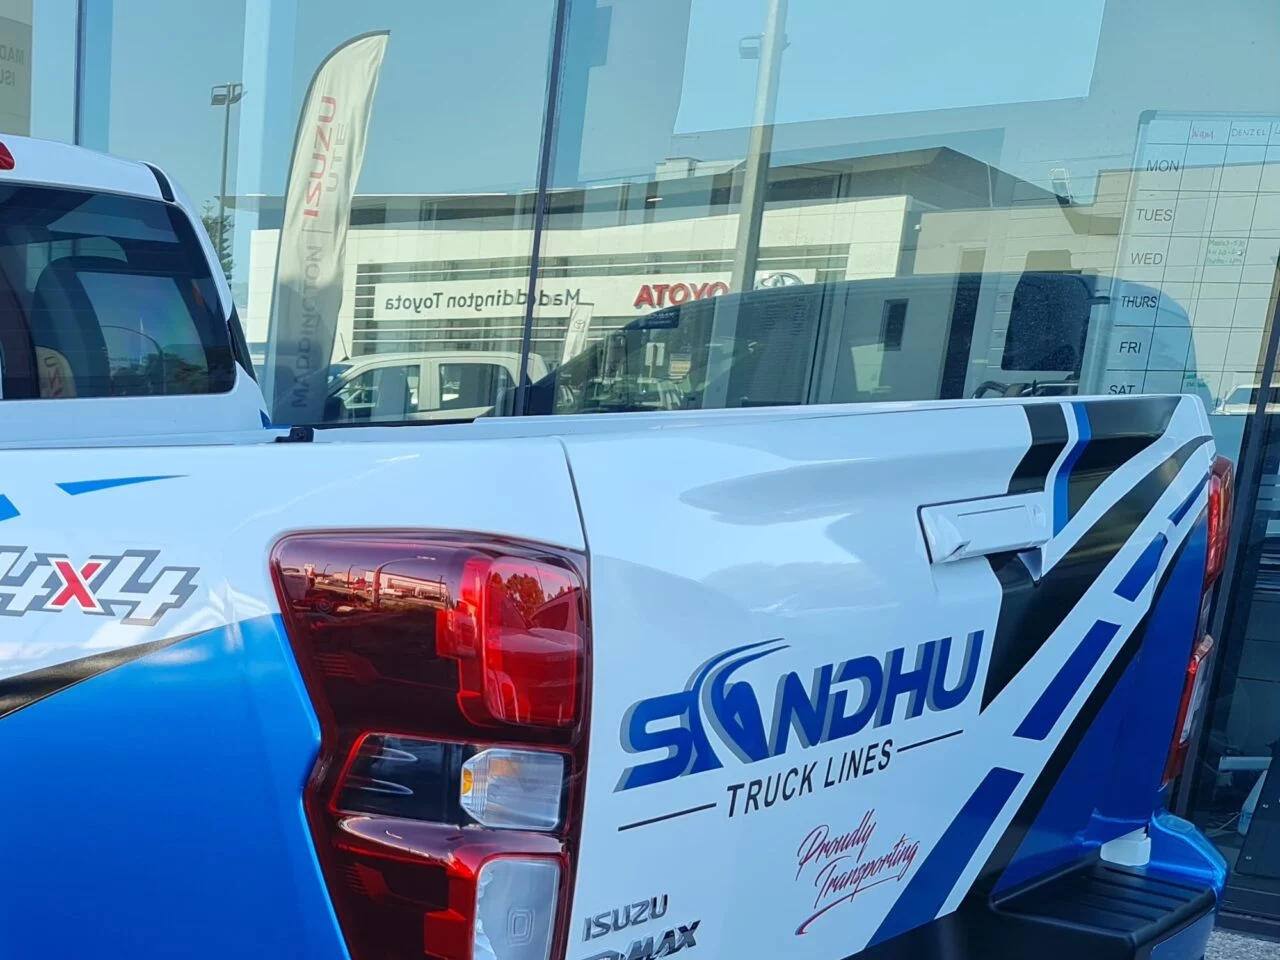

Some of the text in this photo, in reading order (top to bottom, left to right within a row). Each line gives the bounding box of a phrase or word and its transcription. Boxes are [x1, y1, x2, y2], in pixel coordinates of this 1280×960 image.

[303, 96, 337, 218] ISUZU
[326, 122, 349, 193] UTE
[1146, 159, 1180, 173] MON
[1136, 208, 1173, 222] TUES
[1130, 252, 1163, 265] WED
[292, 245, 324, 409] MADDINGTON
[1121, 295, 1158, 309] THURS
[1119, 341, 1142, 353] FRI
[1108, 385, 1136, 395] SAT
[613, 630, 985, 793] SANDHU
[726, 738, 894, 818] TRUCK LINES
[795, 808, 877, 881] Proudly
[804, 833, 920, 920] Transporting
[582, 894, 669, 942] ISUZU
